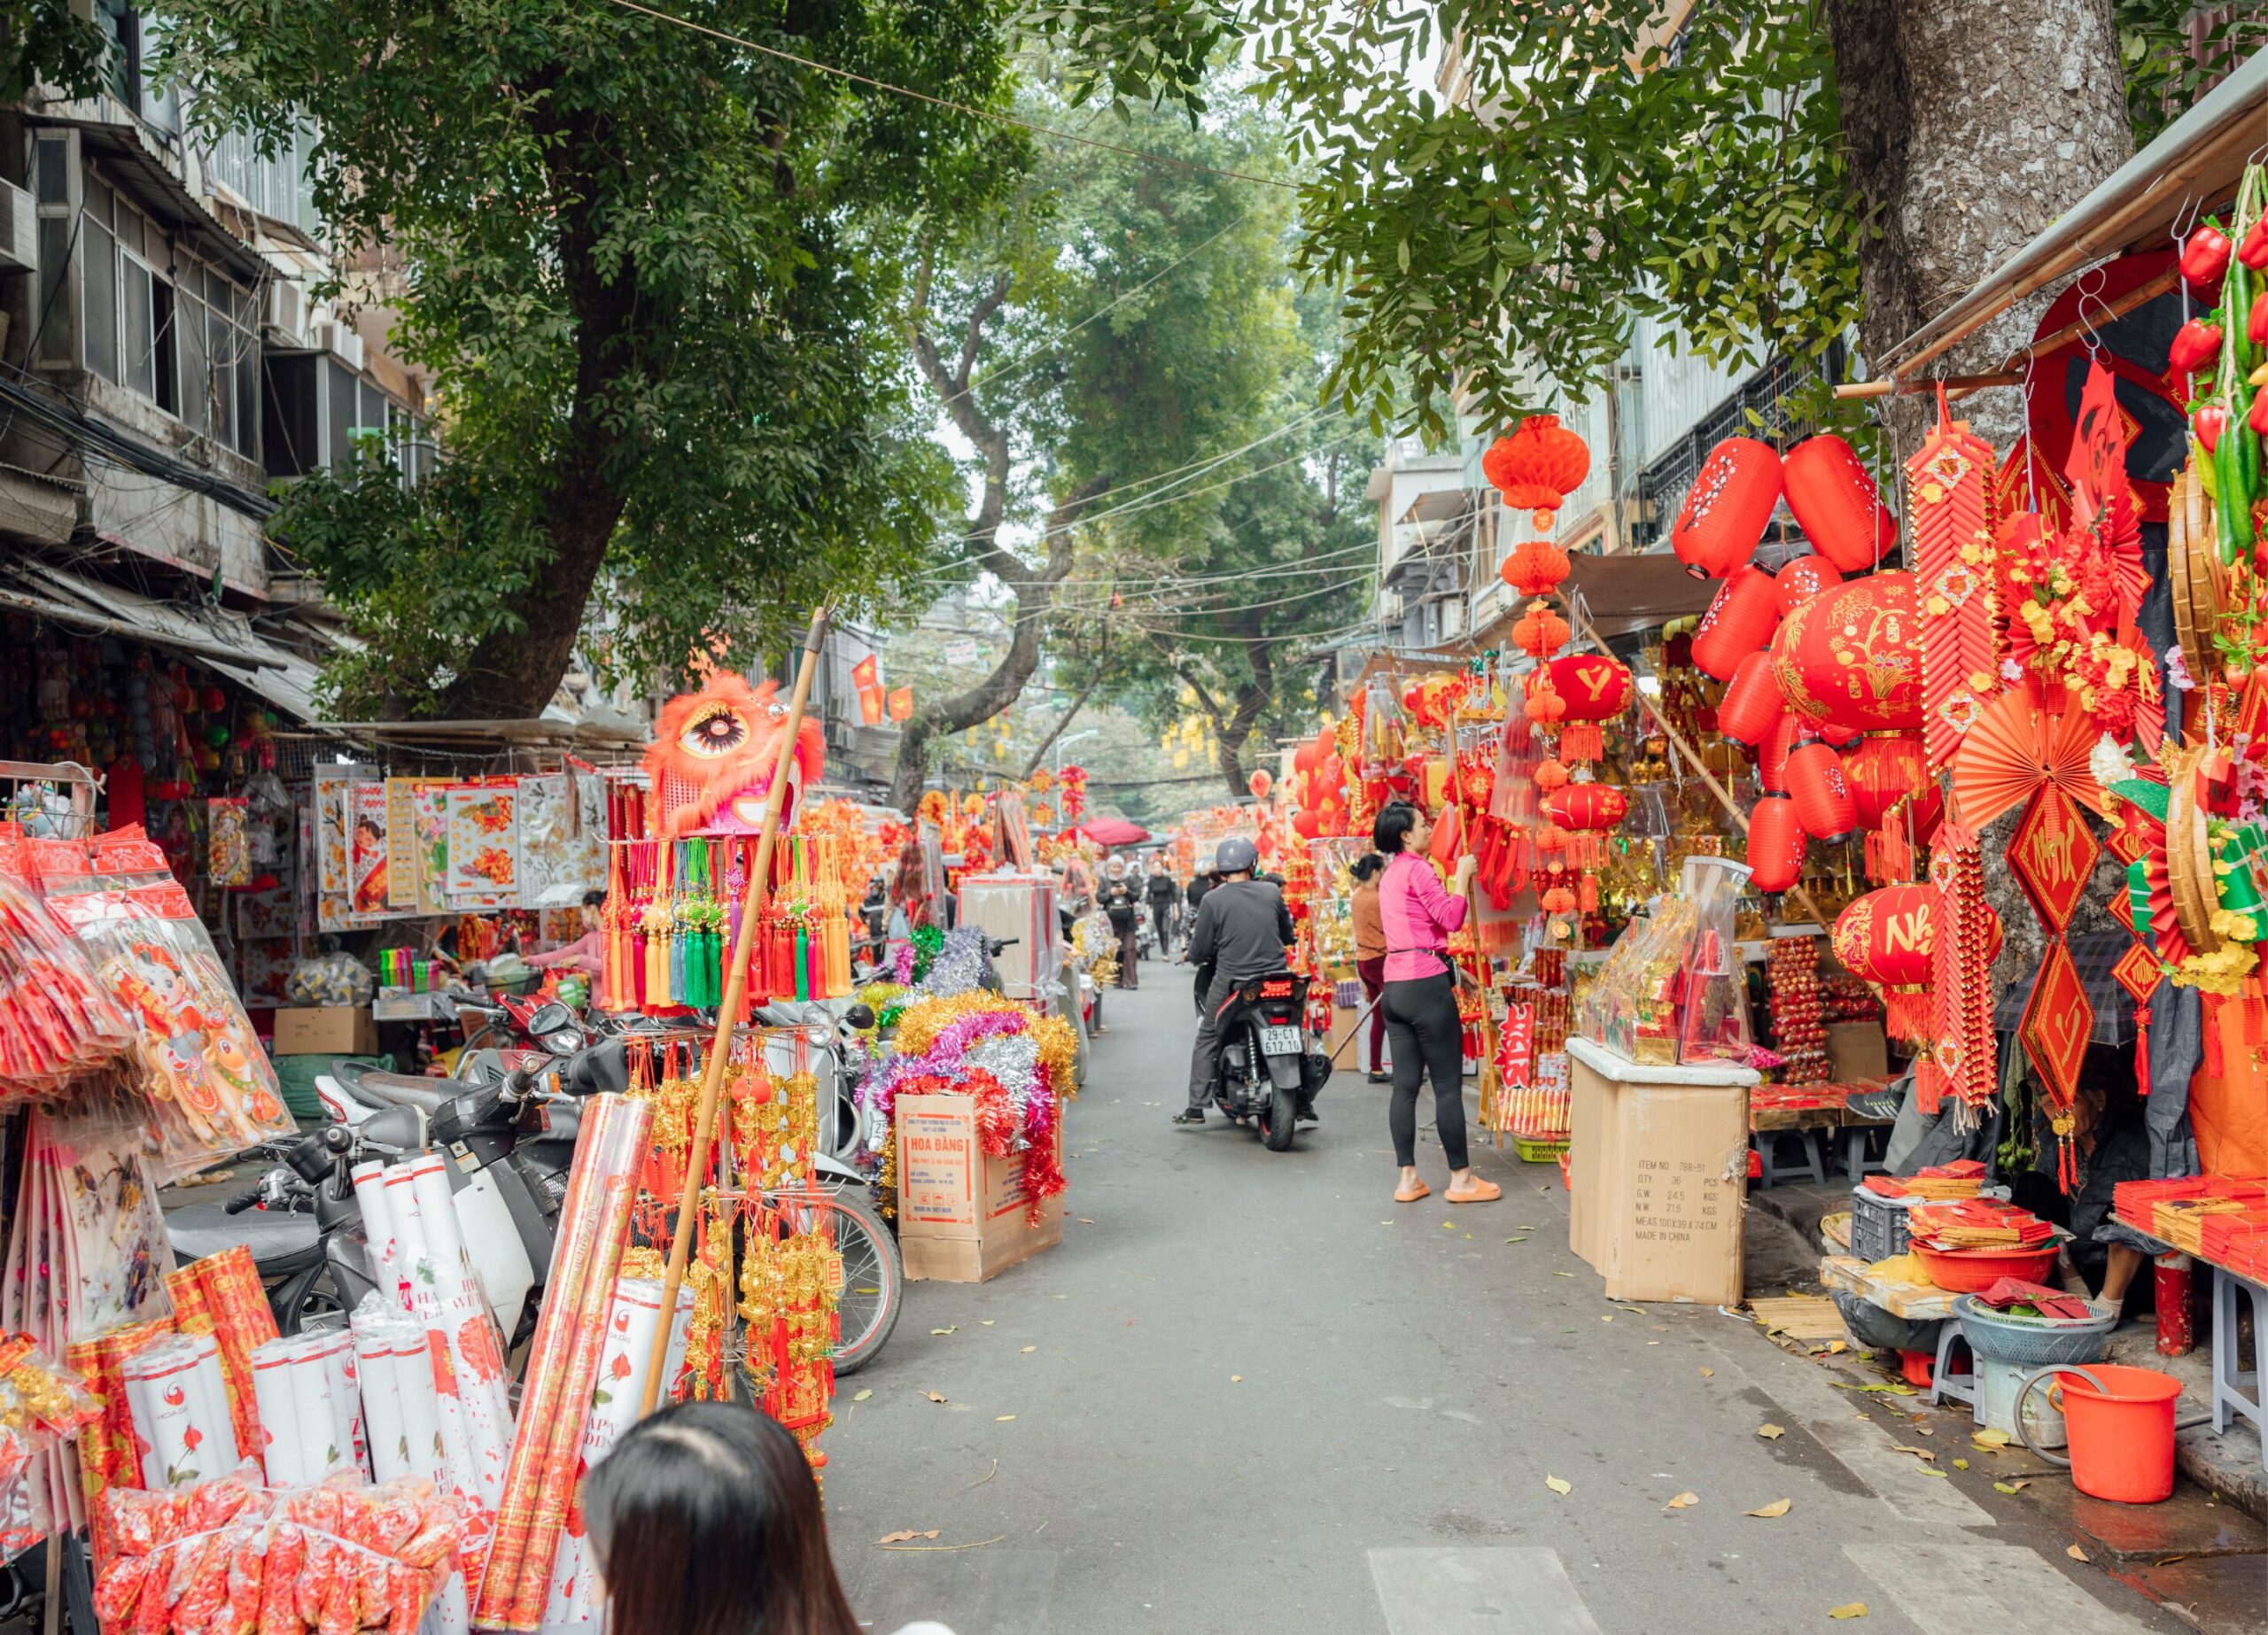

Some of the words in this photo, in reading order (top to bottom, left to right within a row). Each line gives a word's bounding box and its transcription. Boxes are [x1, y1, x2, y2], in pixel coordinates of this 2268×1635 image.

[1267, 1028, 1293, 1041] 29-C1
[912, 1137, 931, 1151] HOA
[936, 1134, 963, 1151] ĐĂNG
[1639, 1159, 1657, 1169] ITEM
[1704, 1178, 1719, 1187] PCS
[1704, 1192, 1718, 1202] KGS
[1702, 1206, 1717, 1215] KGS
[1635, 1231, 1657, 1240] MADE
[1659, 1231, 1666, 1240] IN
[1668, 1232, 1690, 1241] CHINA
